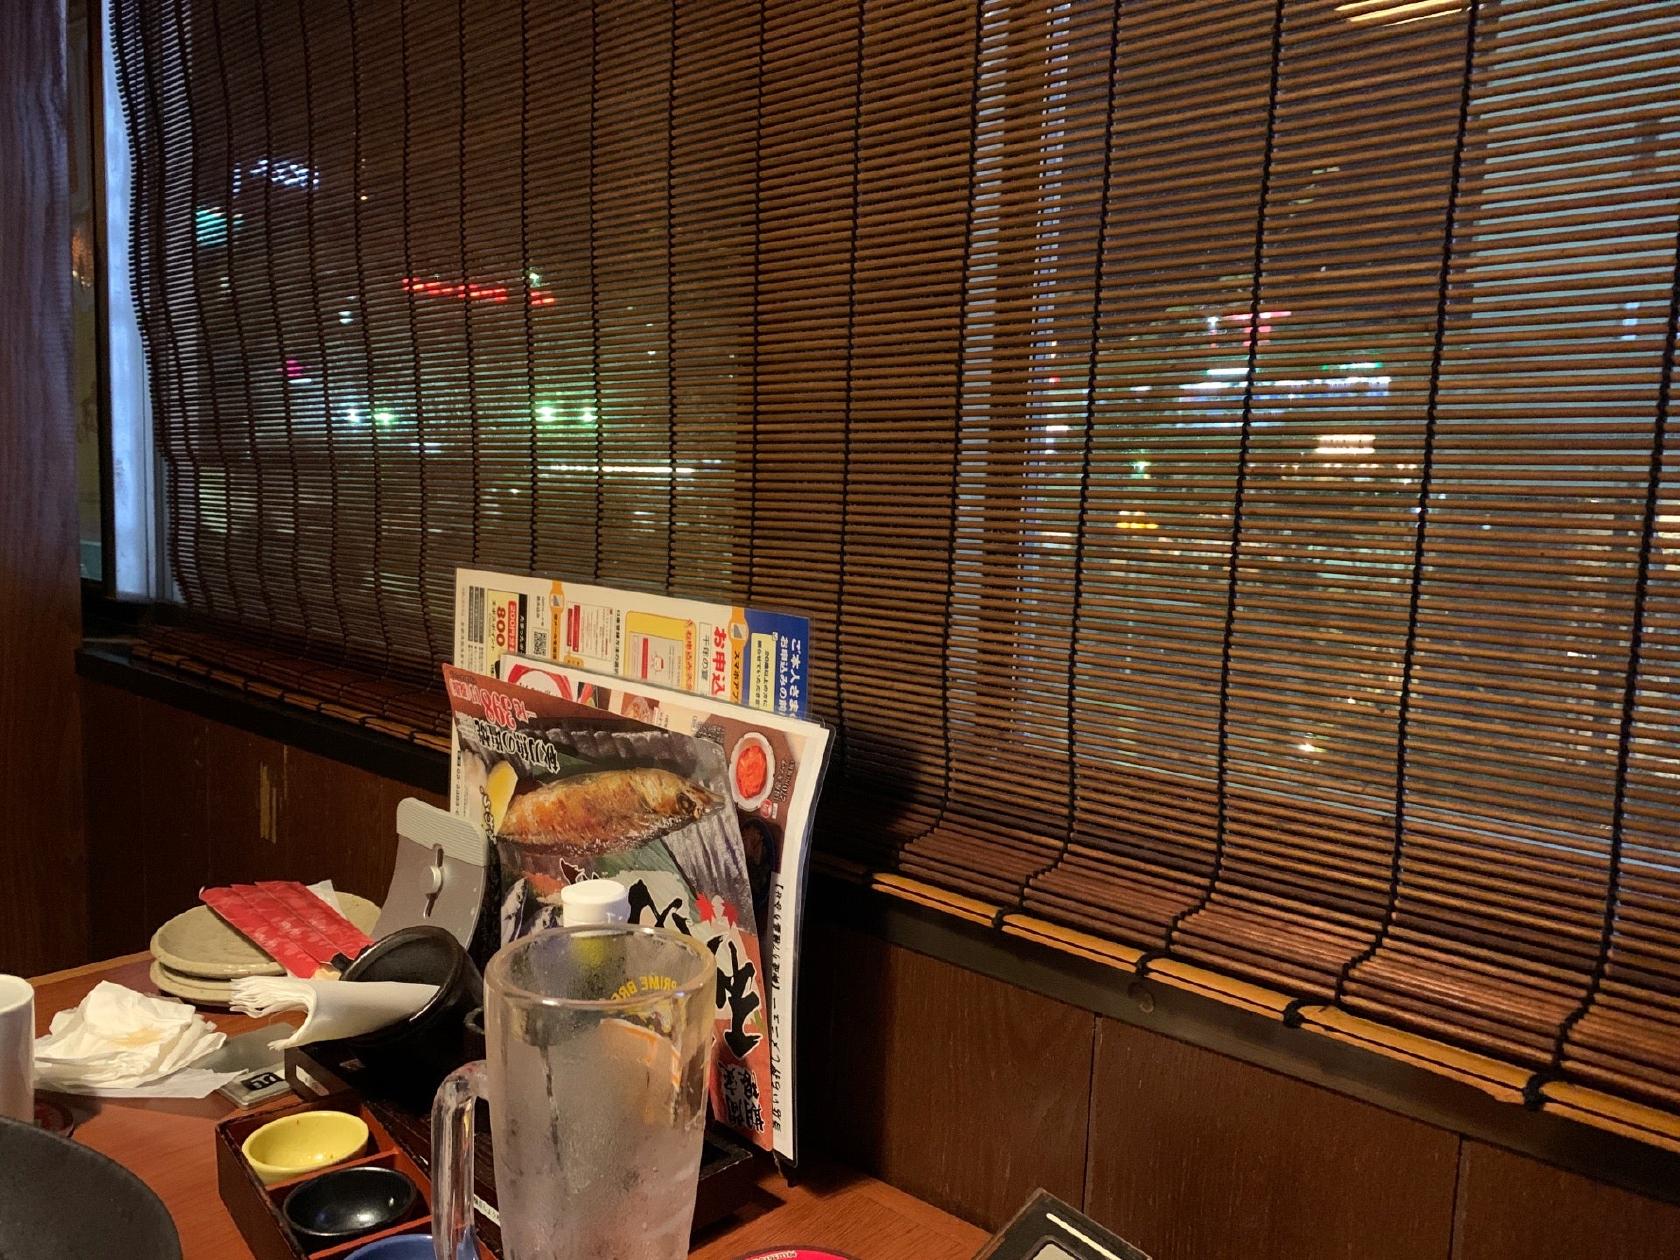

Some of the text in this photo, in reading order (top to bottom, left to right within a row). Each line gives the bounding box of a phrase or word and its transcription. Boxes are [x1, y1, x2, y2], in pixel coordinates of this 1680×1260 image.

[496, 606, 506, 647] 800
[712, 626, 727, 696] お申込
